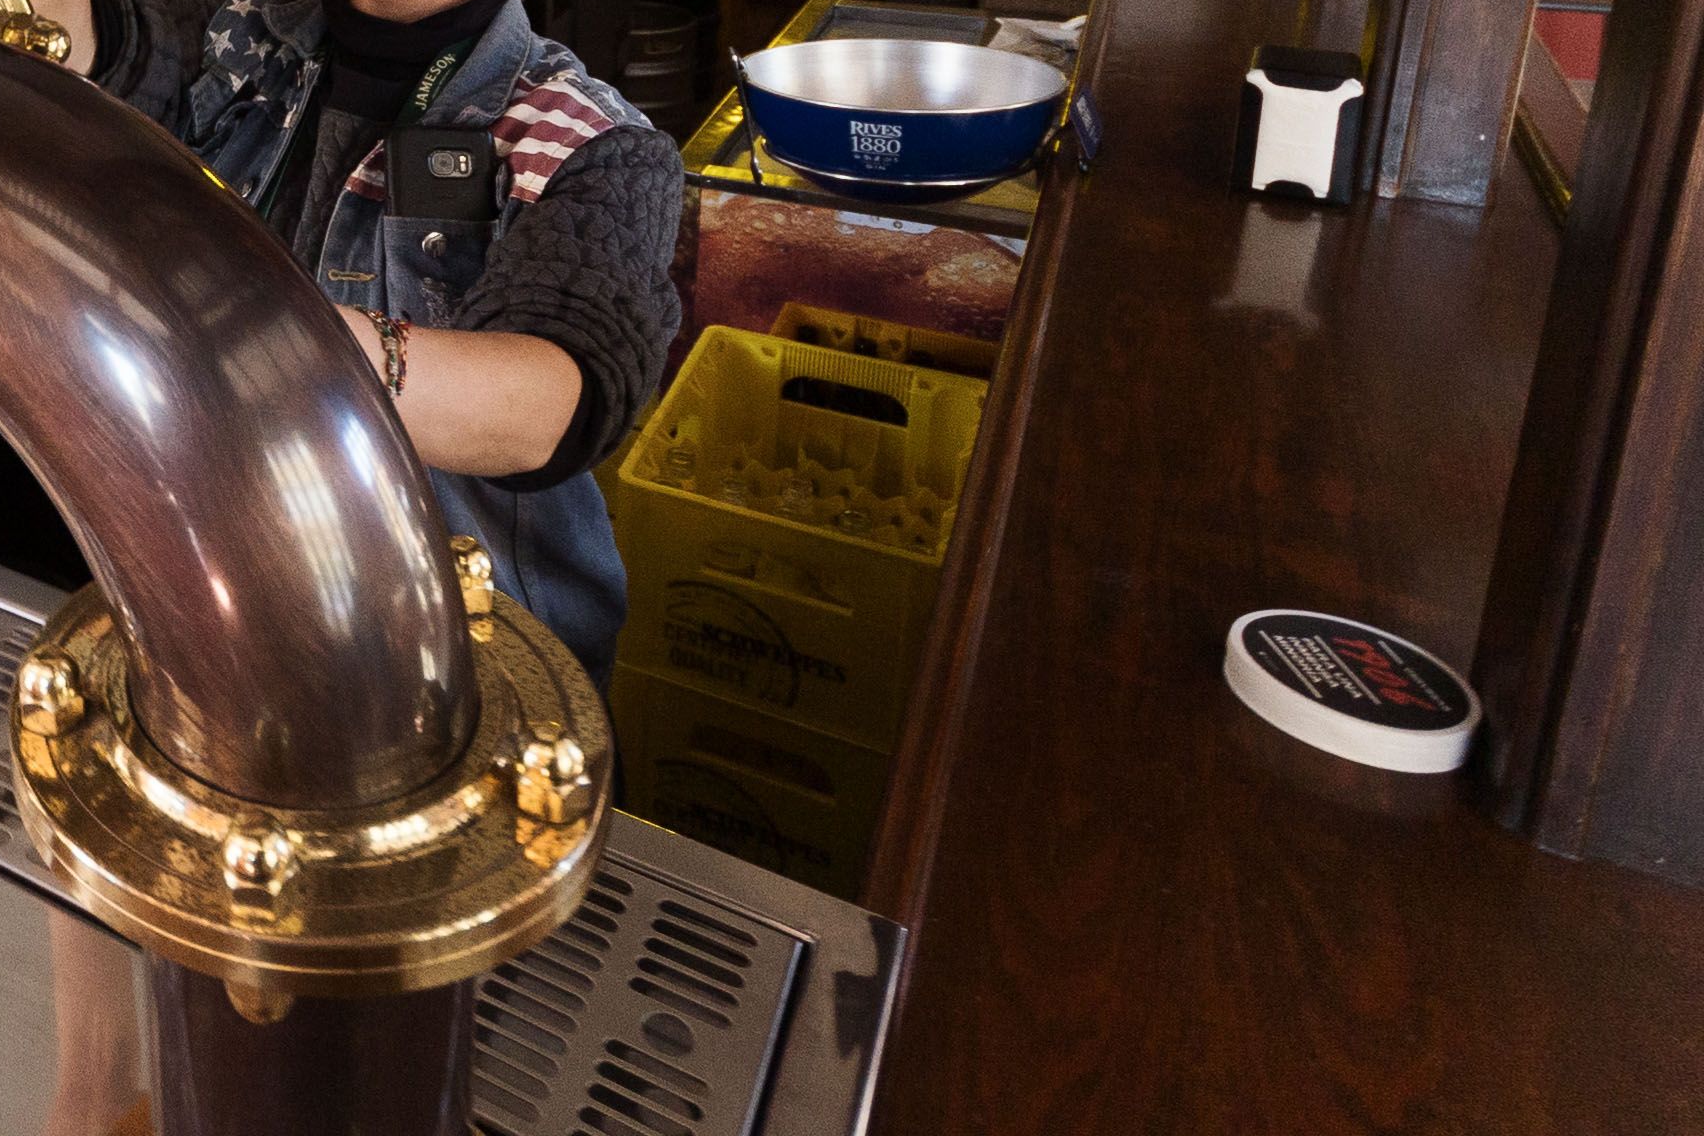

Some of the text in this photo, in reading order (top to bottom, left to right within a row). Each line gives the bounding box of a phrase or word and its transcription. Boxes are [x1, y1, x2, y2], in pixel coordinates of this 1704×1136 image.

[415, 53, 456, 111] JAMESON
[849, 120, 903, 138] RIVES
[851, 136, 901, 154] 1880
